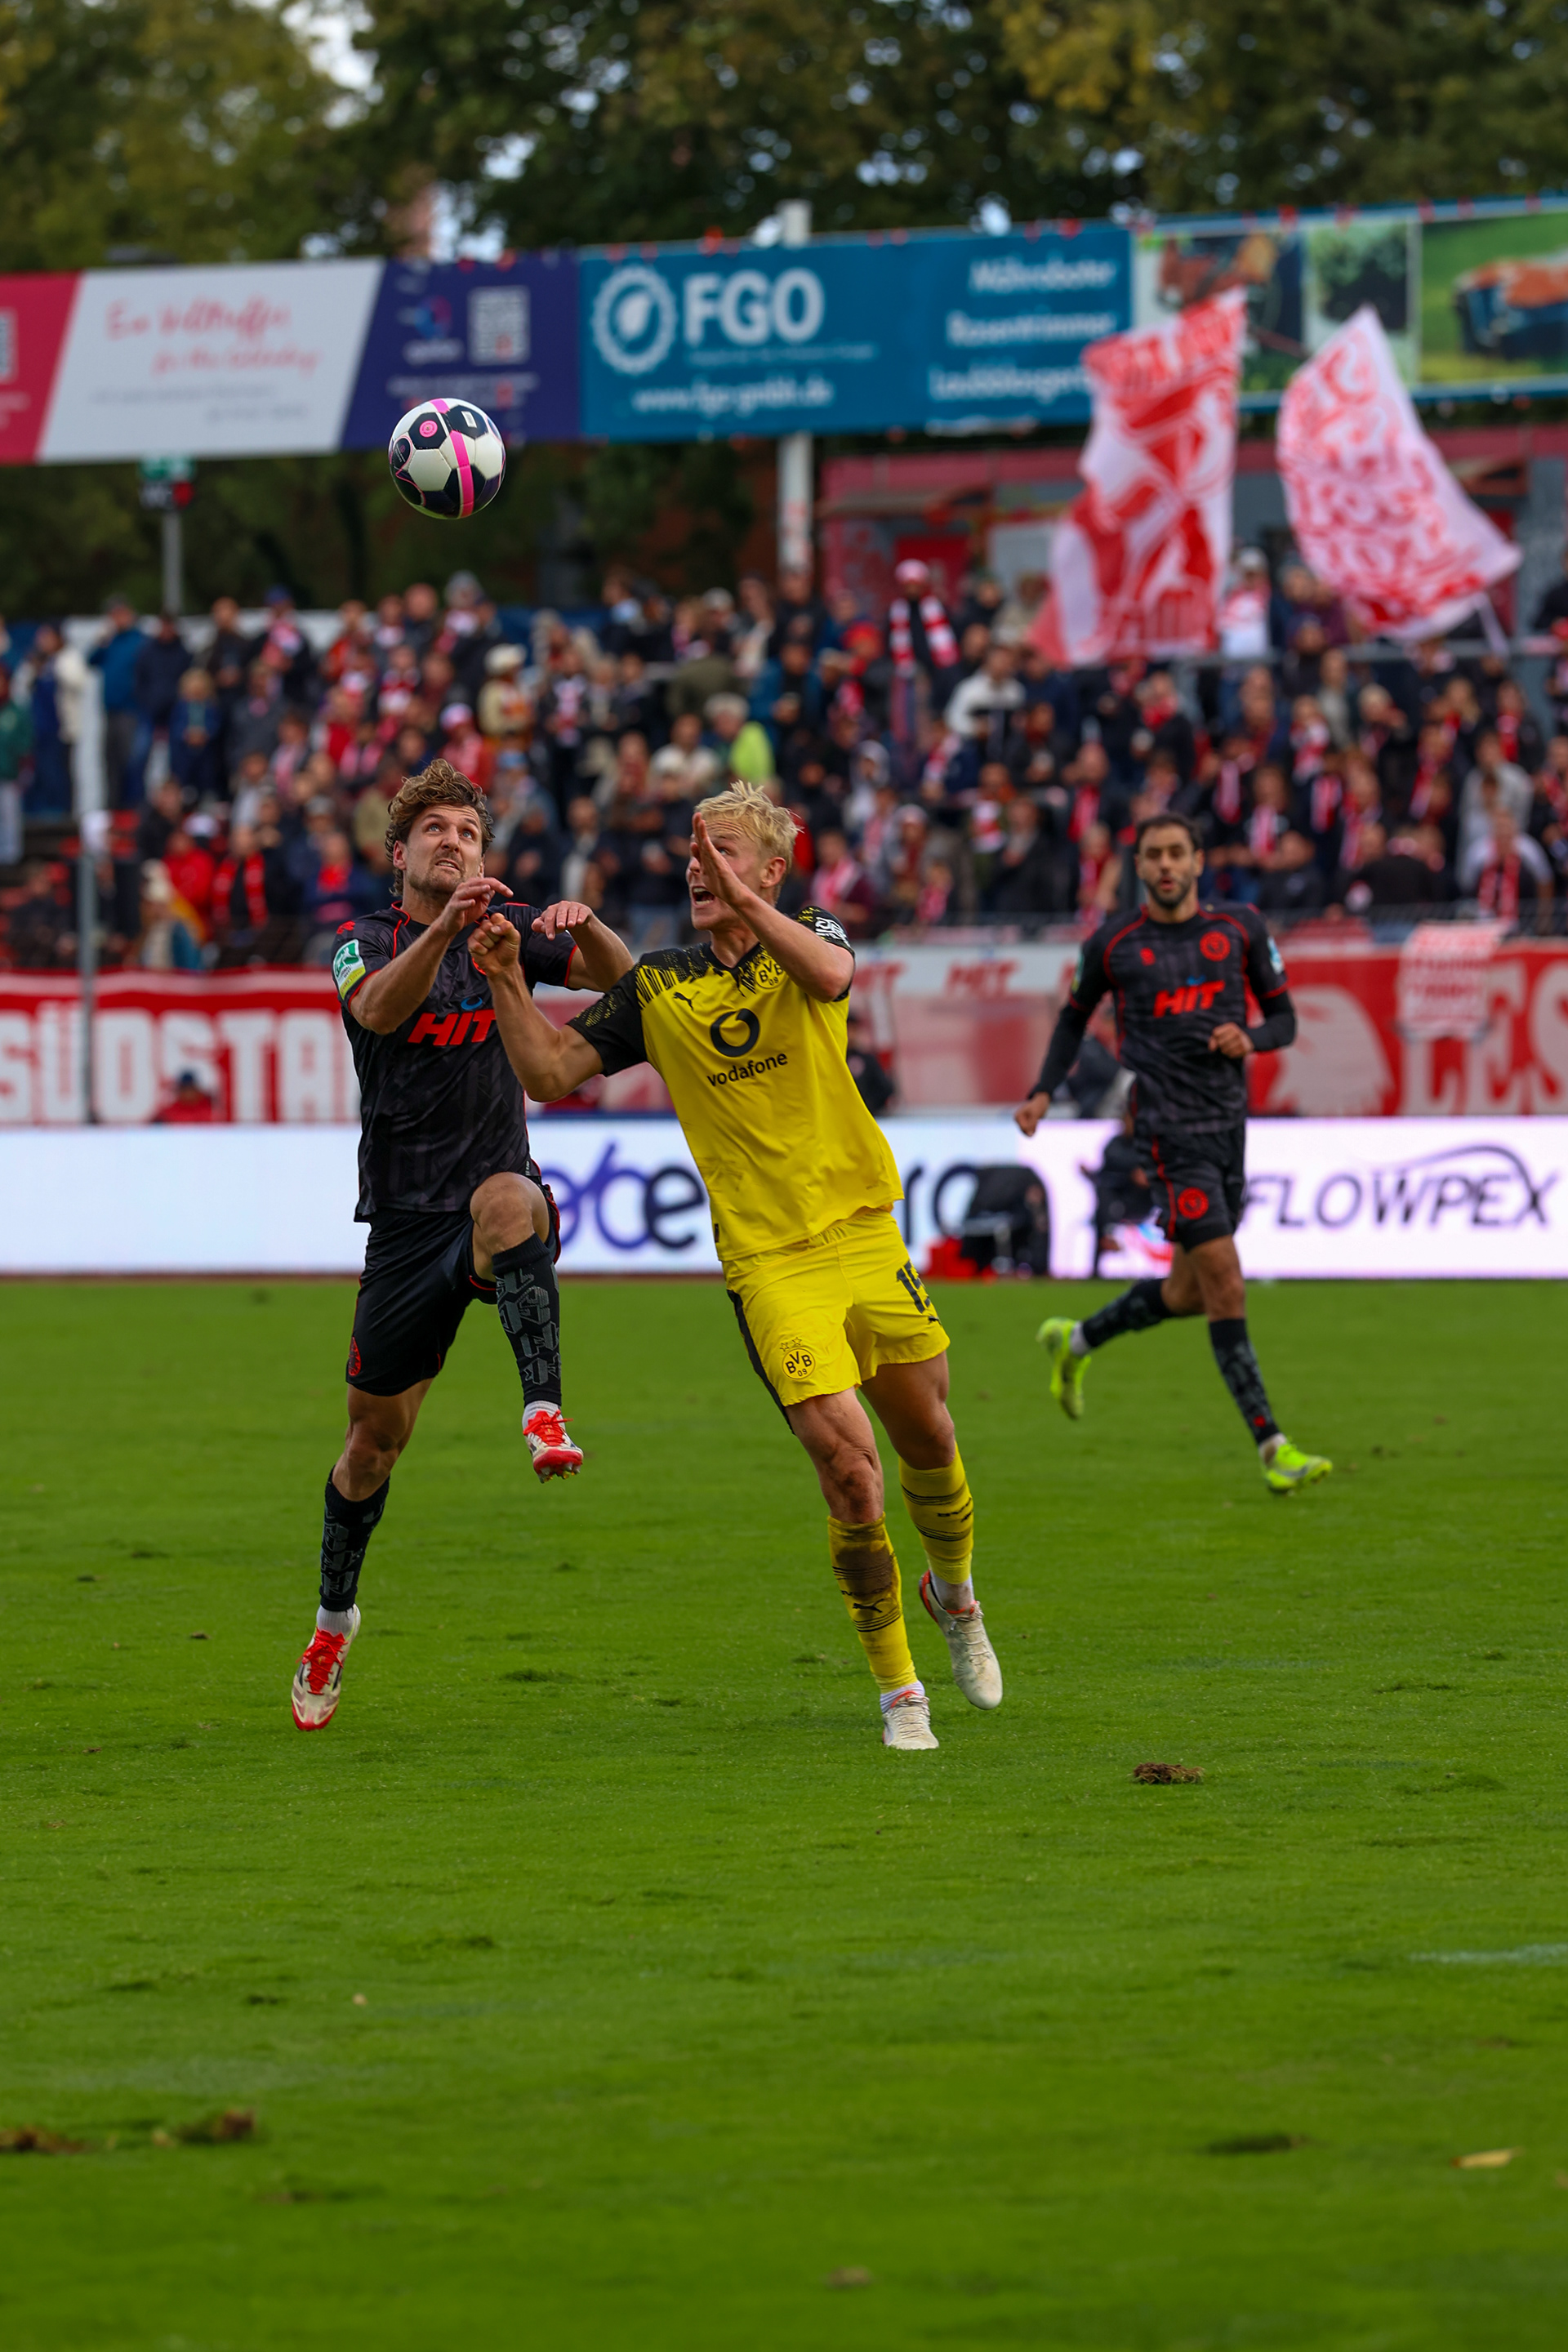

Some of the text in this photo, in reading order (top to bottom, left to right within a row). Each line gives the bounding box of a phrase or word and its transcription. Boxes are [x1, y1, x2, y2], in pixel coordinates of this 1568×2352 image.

[684, 269, 824, 345] FGO
[1153, 981, 1226, 1018] HIT
[408, 1009, 496, 1046] HIT
[0, 1000, 359, 1122] SÜDSTA
[706, 1053, 788, 1087] vodafone
[1239, 1168, 1558, 1227] FLOWPEX
[785, 1351, 813, 1374] BVB
[797, 1368, 808, 1377] 09
